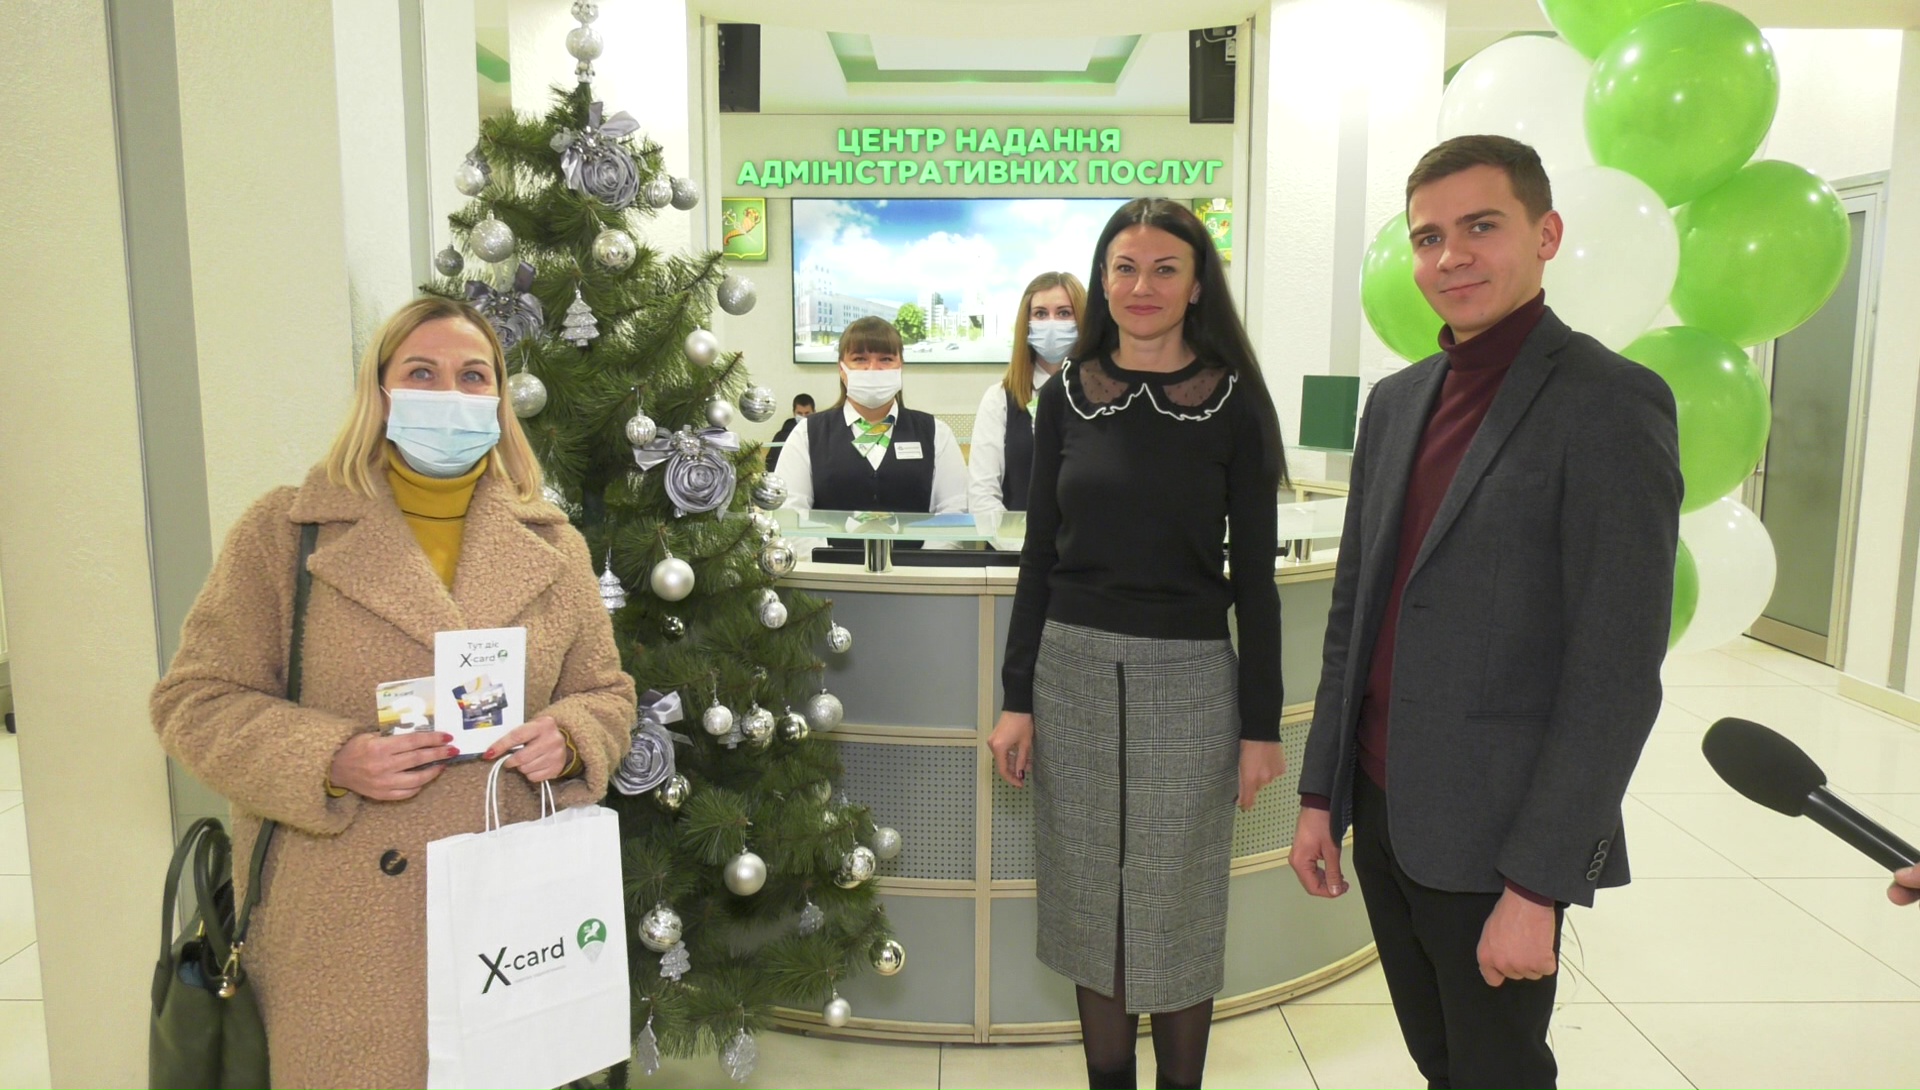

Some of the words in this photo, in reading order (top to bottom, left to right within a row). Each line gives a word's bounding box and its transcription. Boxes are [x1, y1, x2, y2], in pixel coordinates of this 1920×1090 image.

[837, 128, 946, 156] ЦЕНТР
[956, 128, 1121, 156] НАДАННЯ
[736, 159, 1078, 188] АДМІНІСТРАТИВНИХ
[1088, 159, 1223, 185] ПОСЛУГ
[460, 653, 496, 668] X-card
[478, 936, 565, 994] X-card
